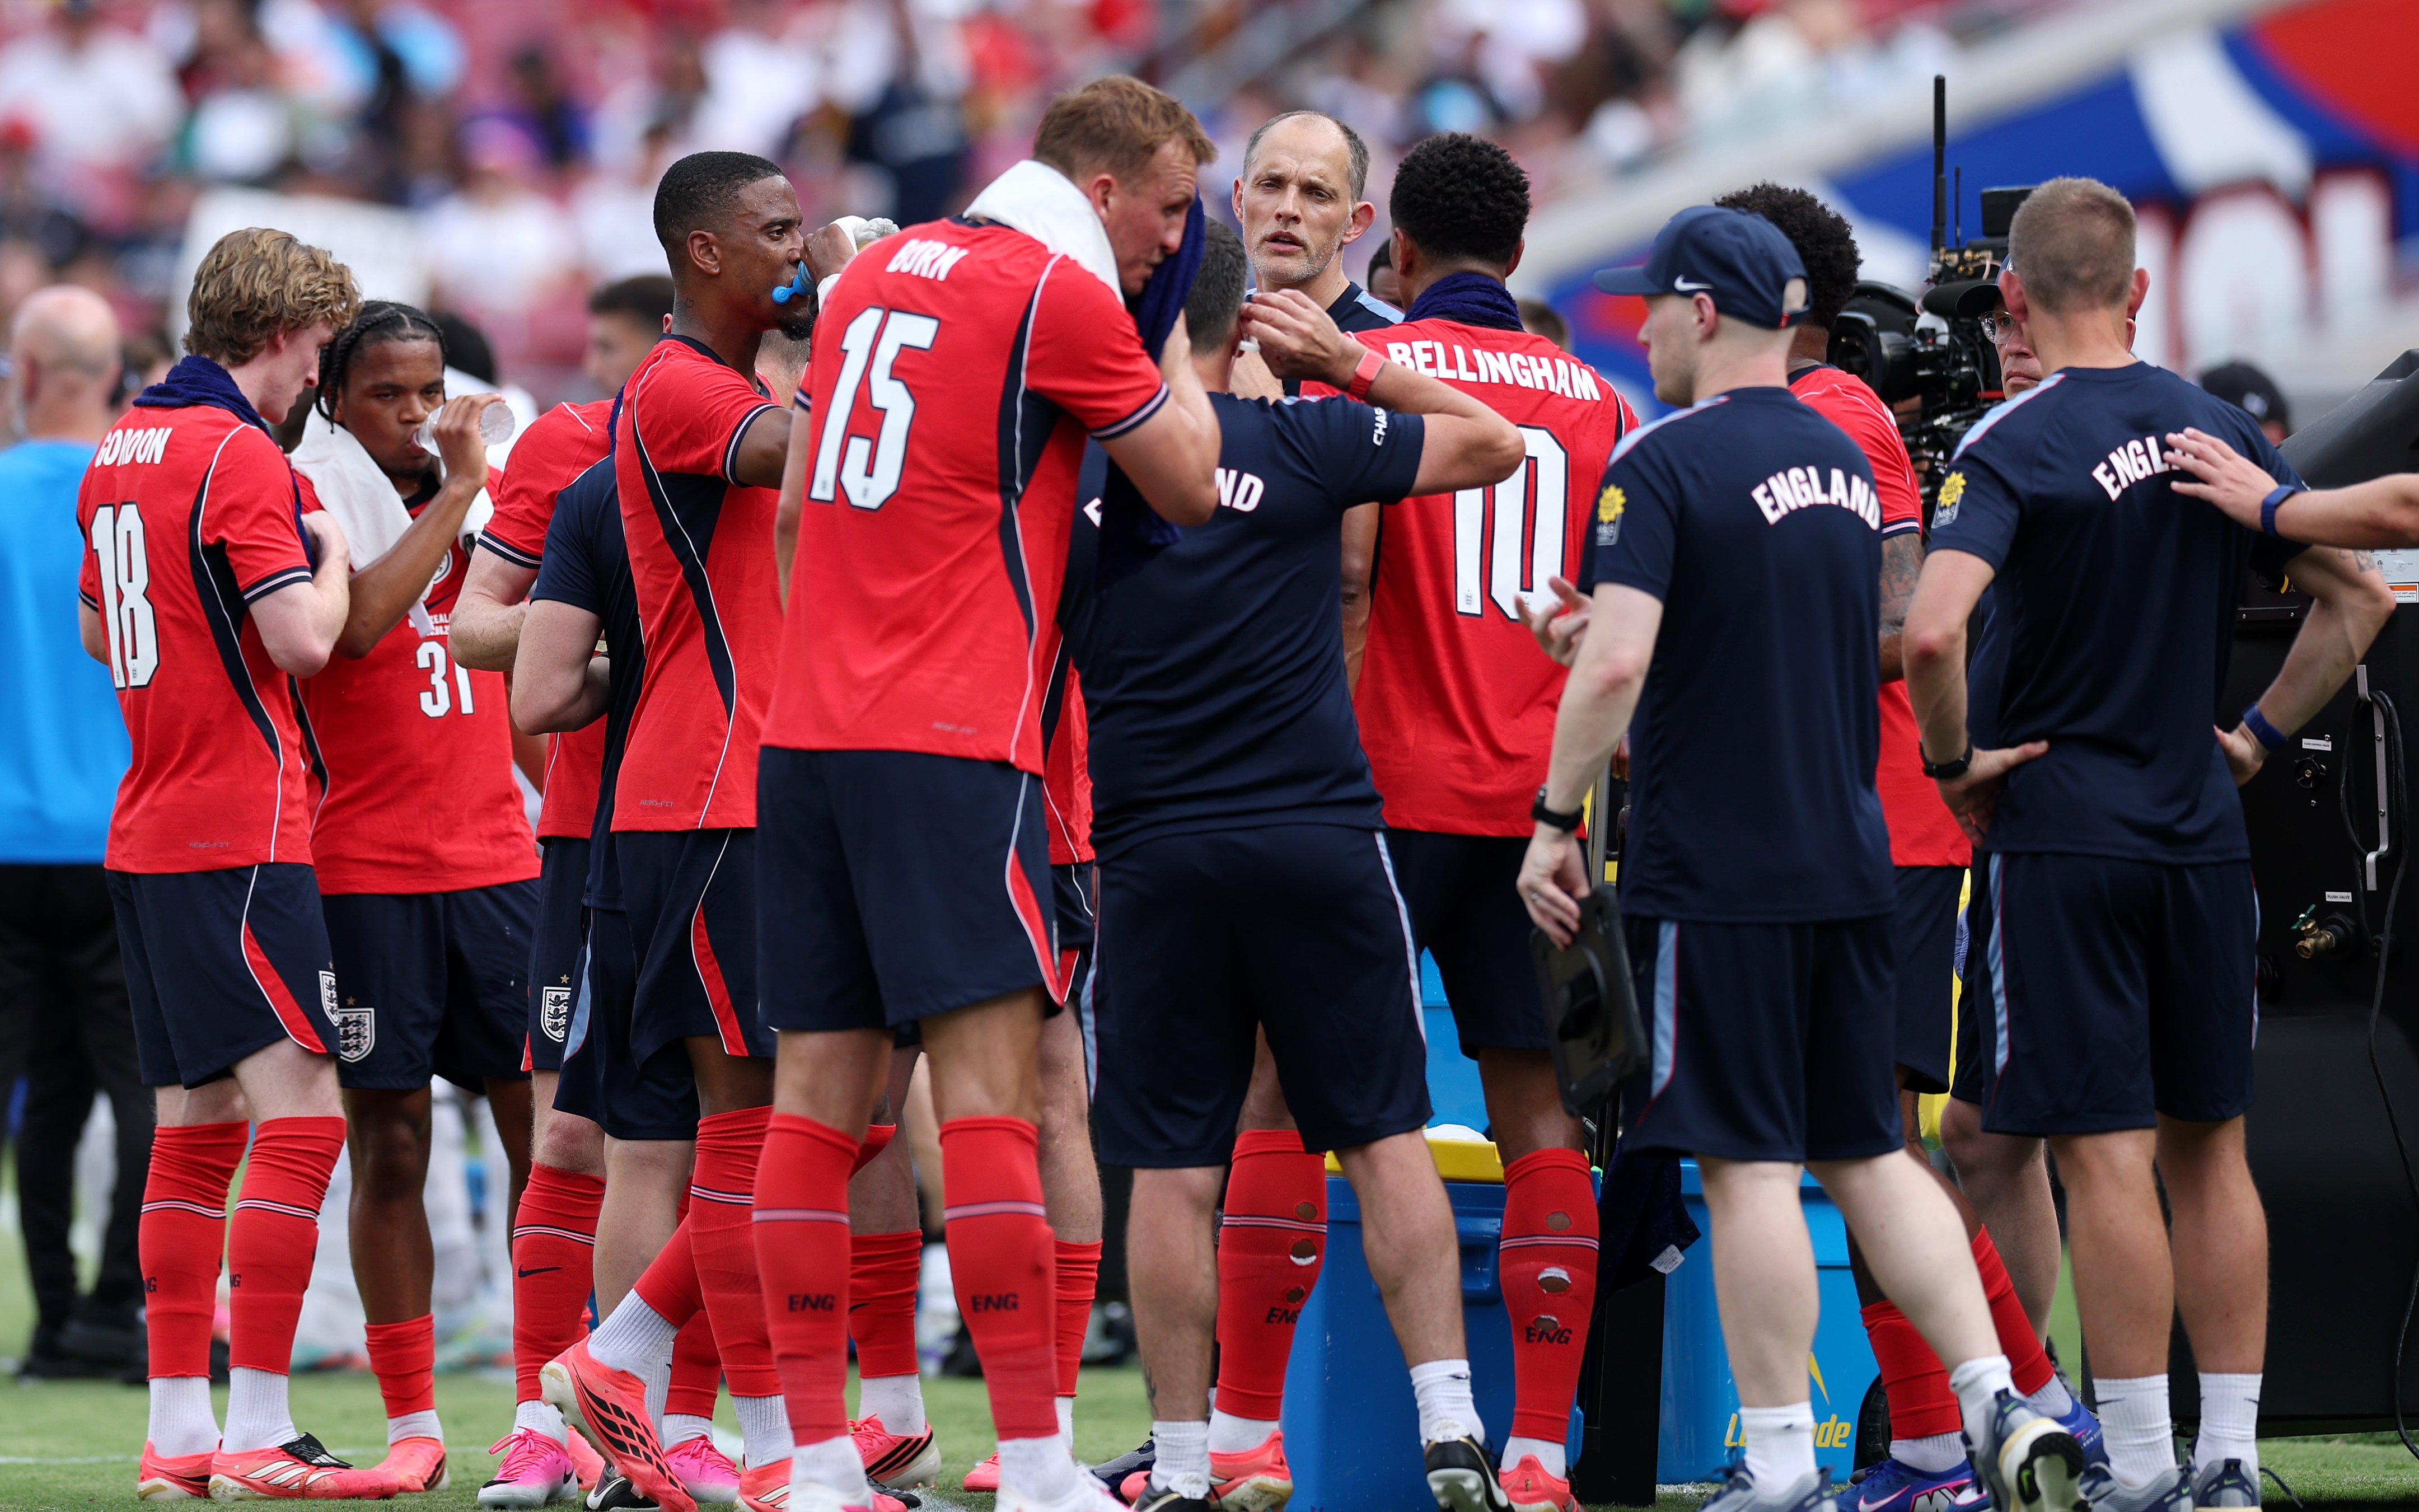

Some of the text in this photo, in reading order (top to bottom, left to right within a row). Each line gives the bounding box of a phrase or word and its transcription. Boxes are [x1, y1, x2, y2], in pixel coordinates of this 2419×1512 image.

[885, 238, 969, 282] BURN
[1386, 340, 1602, 401] BELLINGHAM
[808, 305, 941, 511] 15
[95, 428, 173, 468] GORDON
[1454, 424, 1568, 622] 10
[1751, 466, 1880, 531] ENGLAND
[90, 501, 160, 691] 18
[416, 640, 475, 719] 31
[788, 1294, 836, 1312] ENG
[971, 1293, 1019, 1313] ENG
[1524, 1326, 1573, 1344] ENG
